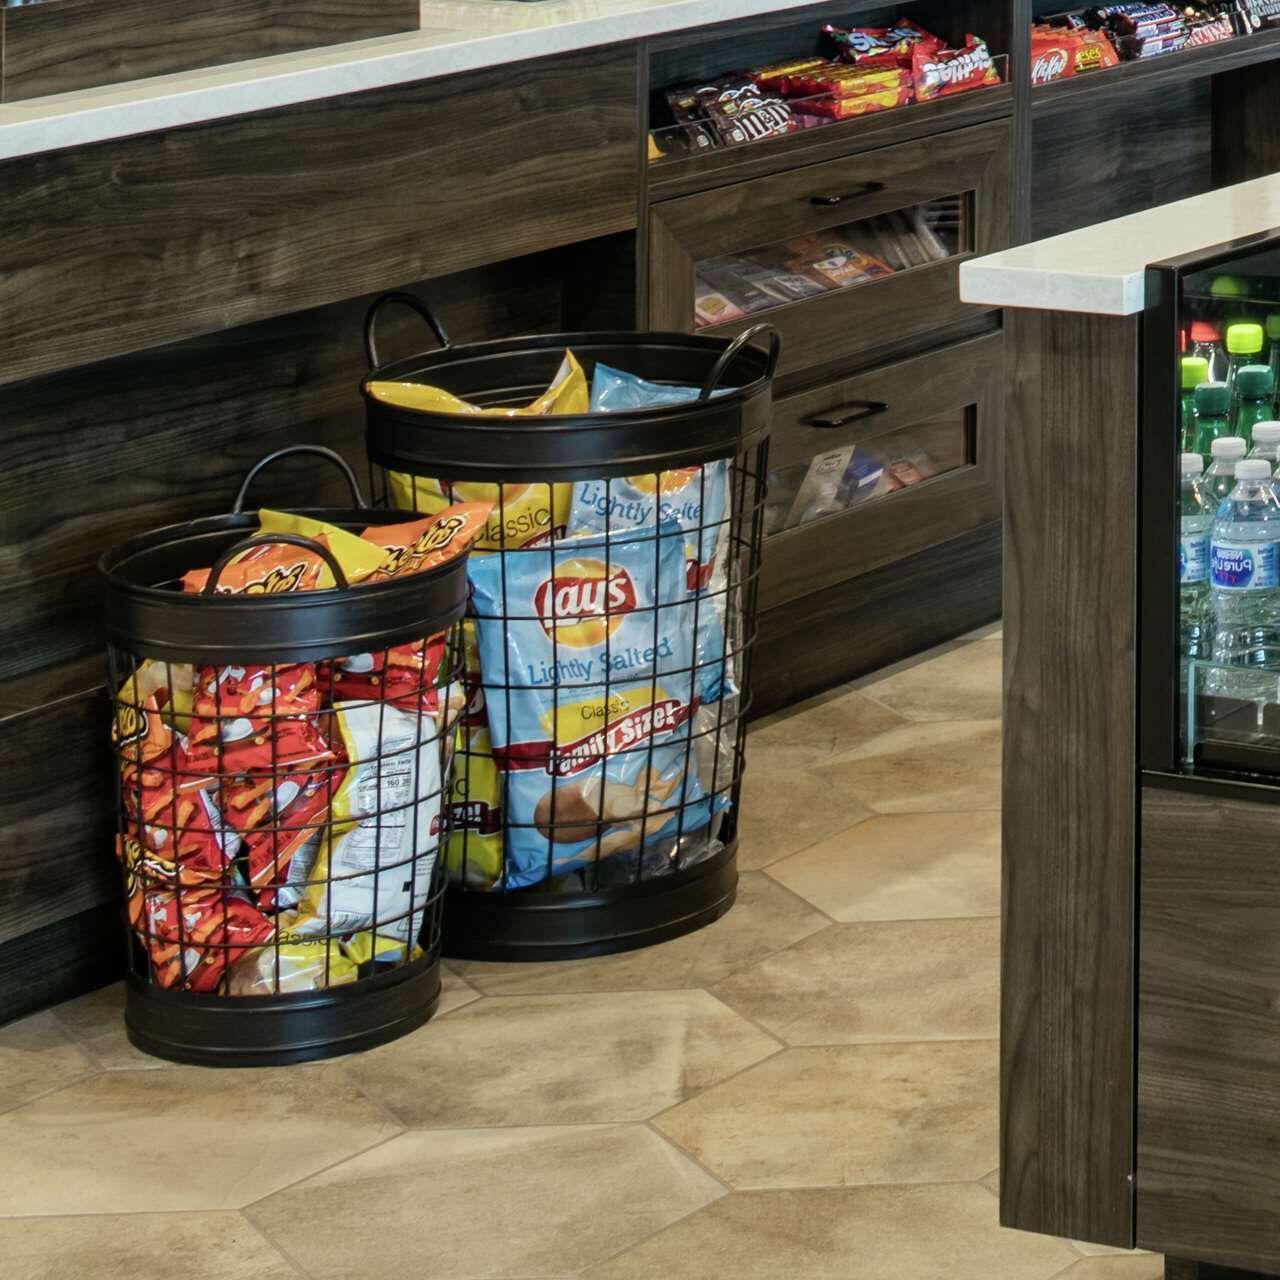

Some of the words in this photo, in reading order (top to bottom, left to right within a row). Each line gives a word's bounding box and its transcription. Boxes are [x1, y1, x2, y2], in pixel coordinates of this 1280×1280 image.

[579, 480, 655, 524] Lightly
[540, 570, 629, 626] Lay's
[527, 651, 595, 687] Lightly
[597, 636, 674, 675] Salted
[580, 698, 631, 721] Classic
[548, 729, 611, 775] Family
[612, 701, 679, 750] Size!
